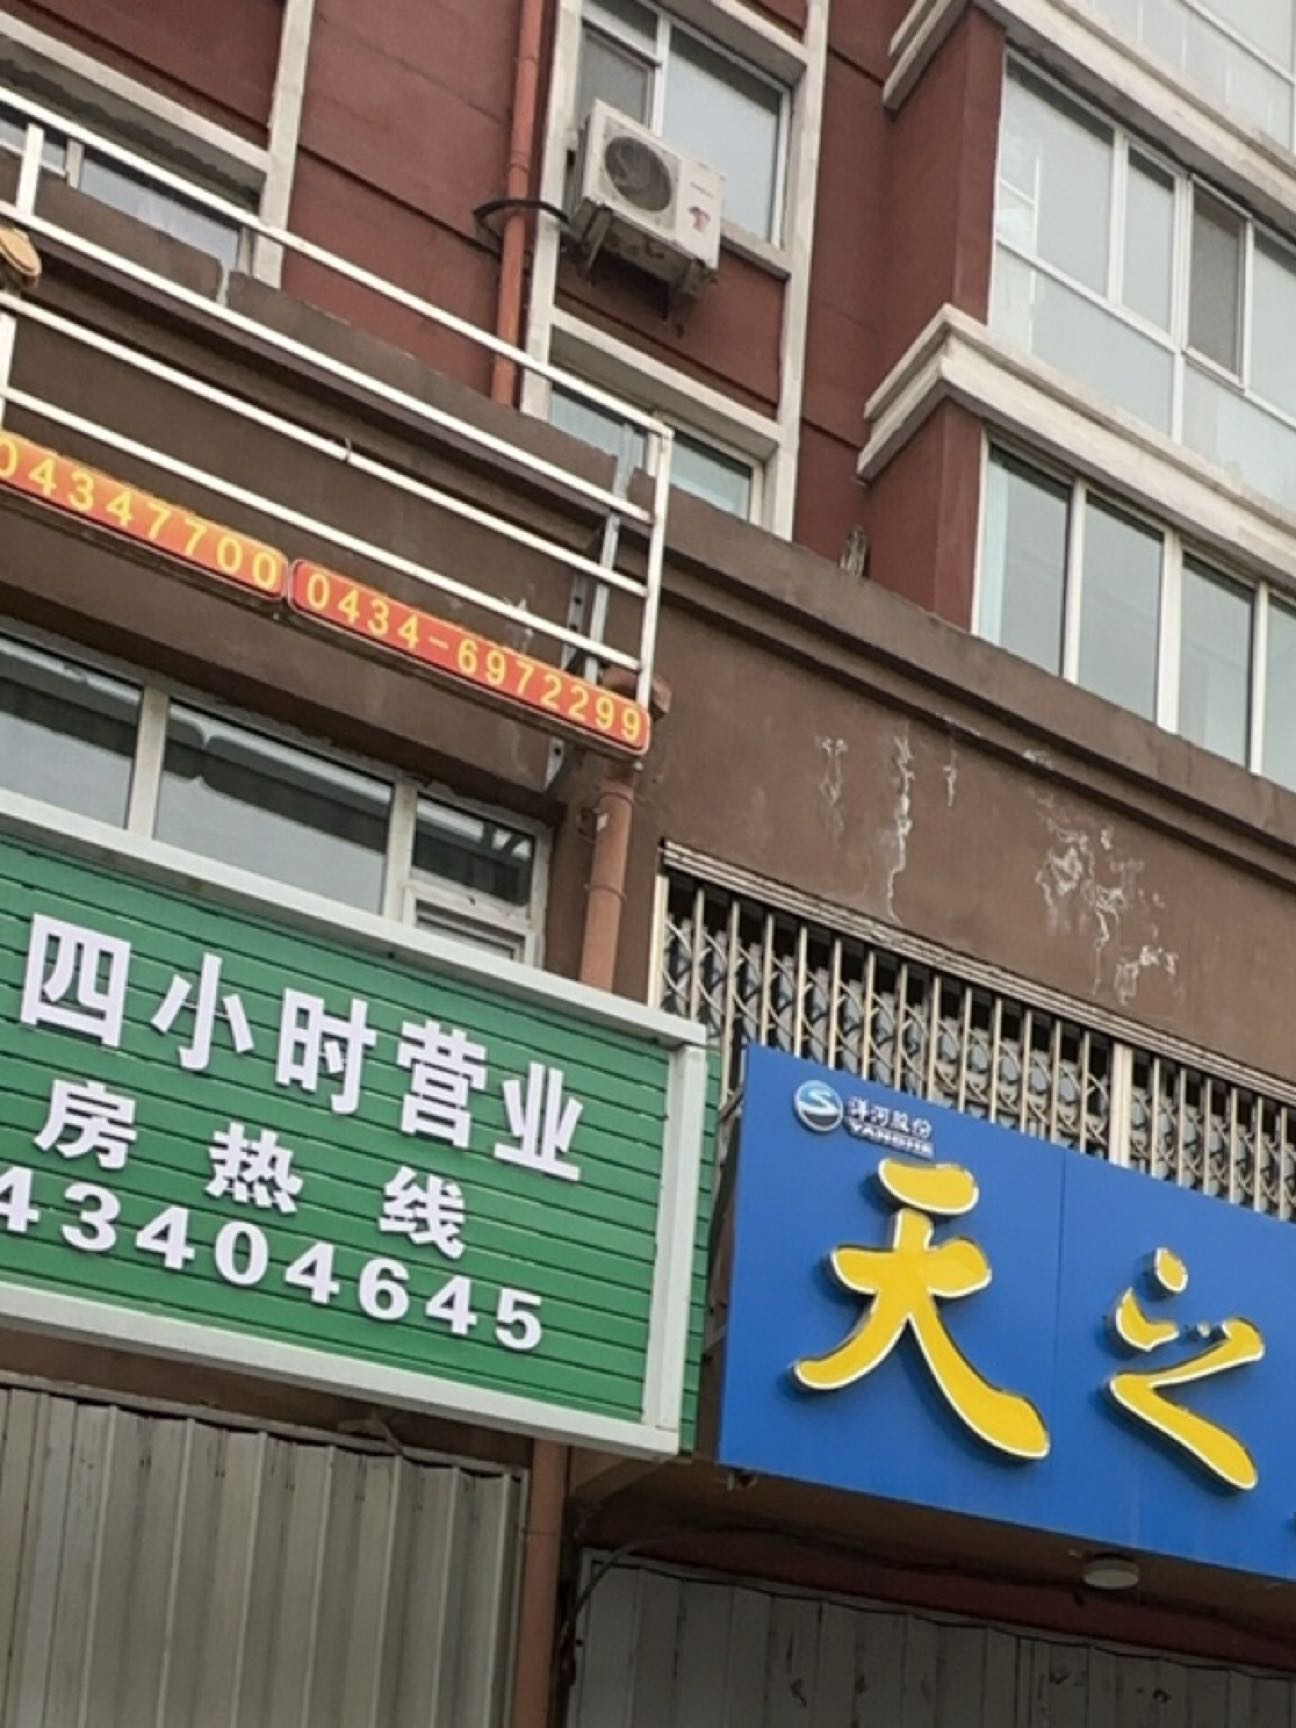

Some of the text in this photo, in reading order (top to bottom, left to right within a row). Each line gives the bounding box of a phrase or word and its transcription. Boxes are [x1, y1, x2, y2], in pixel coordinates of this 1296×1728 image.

[307, 573, 642, 744] 0434-6972299
[20, 912, 584, 1182] 四小时营业
[0, 1166, 543, 1351] 43404645
